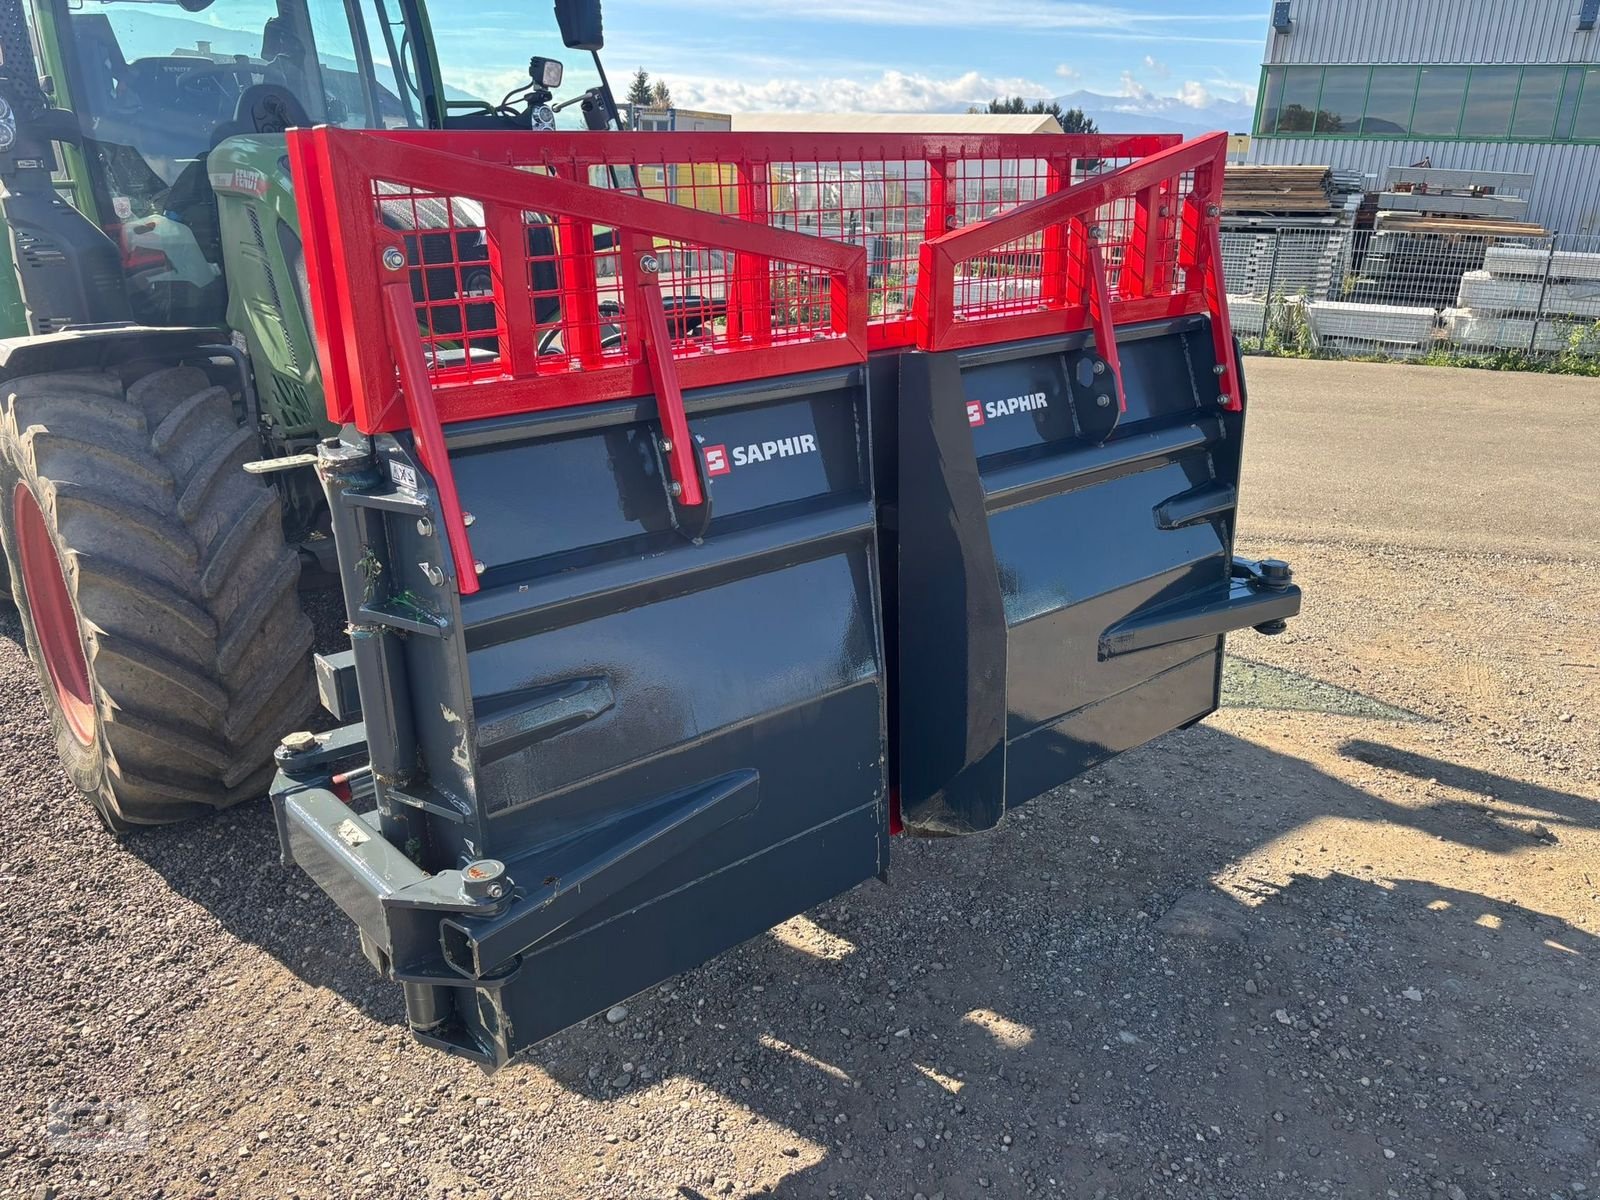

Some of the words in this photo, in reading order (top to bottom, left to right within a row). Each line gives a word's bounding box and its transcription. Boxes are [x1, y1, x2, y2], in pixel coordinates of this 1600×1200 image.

[234, 168, 259, 191] FENDT
[985, 392, 1048, 419] SAPHIR
[732, 434, 816, 466] SAPHIR
